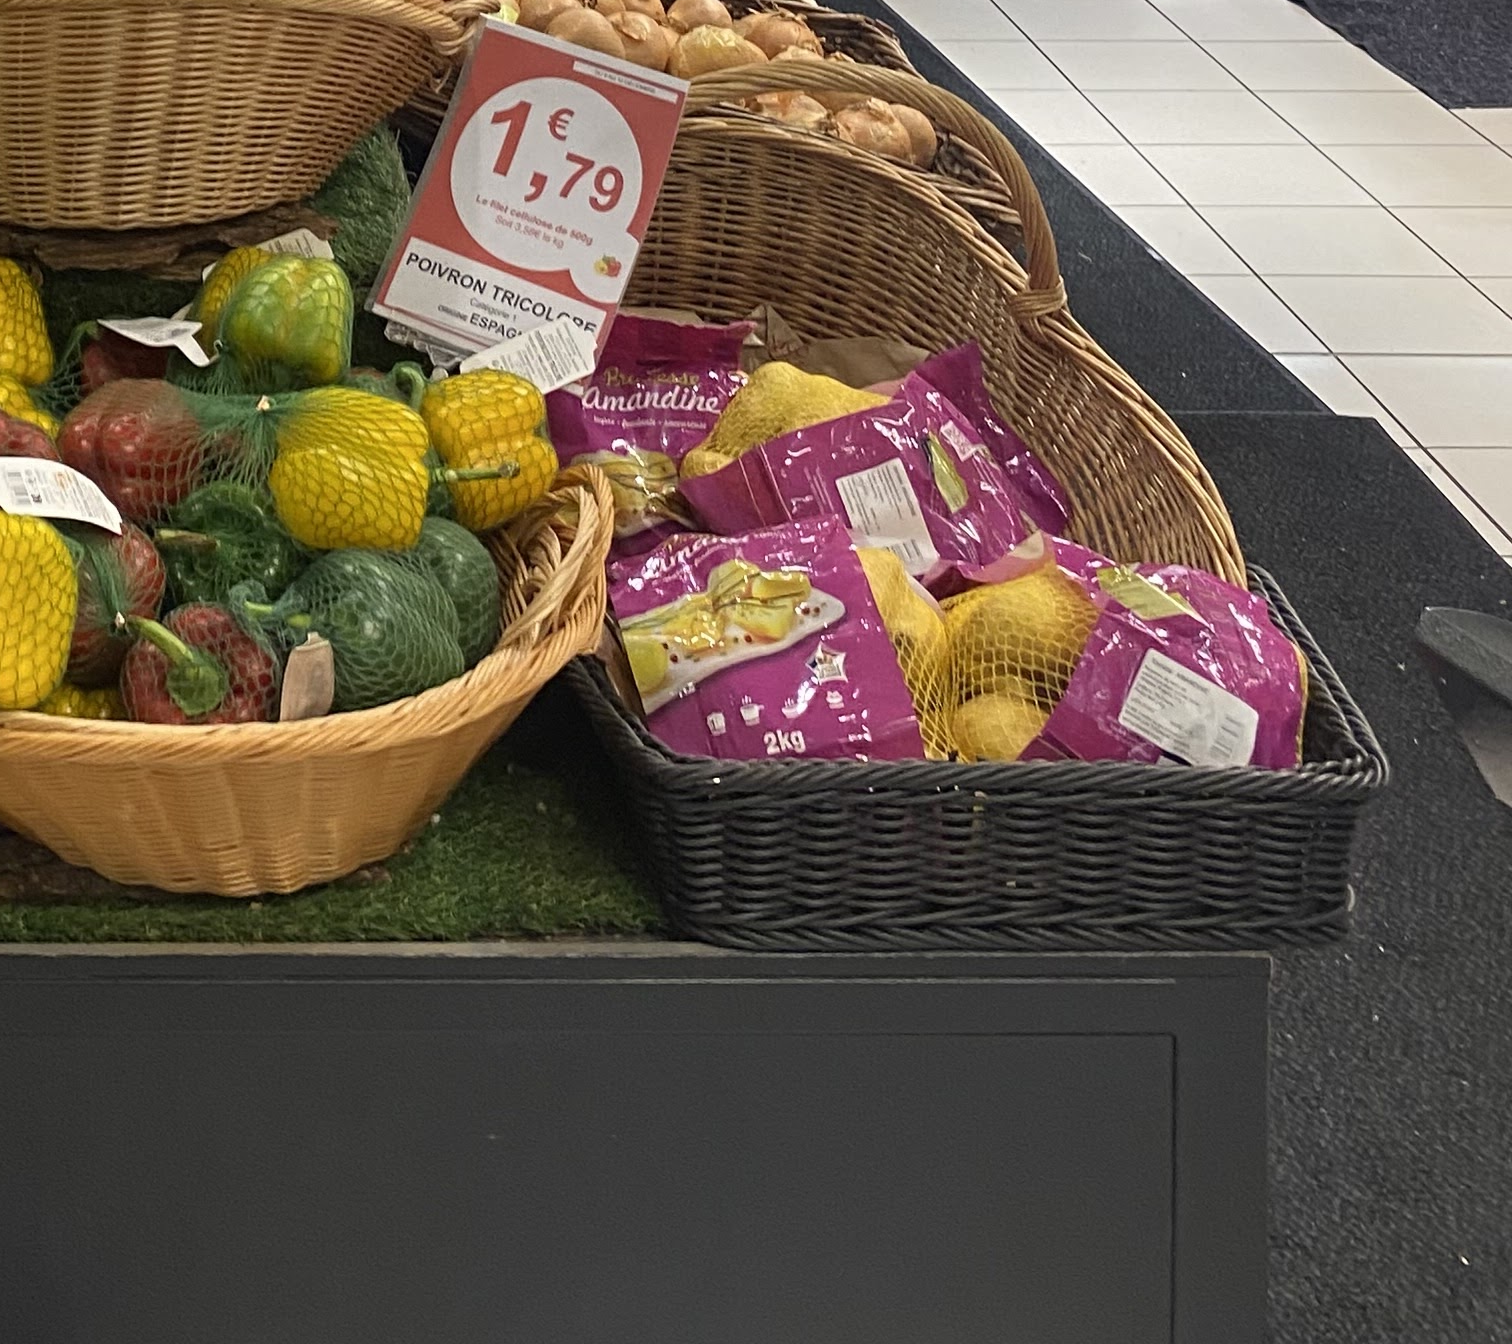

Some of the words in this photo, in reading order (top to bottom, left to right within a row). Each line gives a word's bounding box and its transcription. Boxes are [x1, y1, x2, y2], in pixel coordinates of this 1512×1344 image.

[510, 208, 553, 230] cellulose
[555, 224, 567, 235] de
[570, 229, 593, 246] 500g
[553, 236, 564, 249] kg
[406, 252, 487, 295] POIVRON
[469, 312, 524, 339] ESPAG
[763, 728, 807, 756] 2kg
